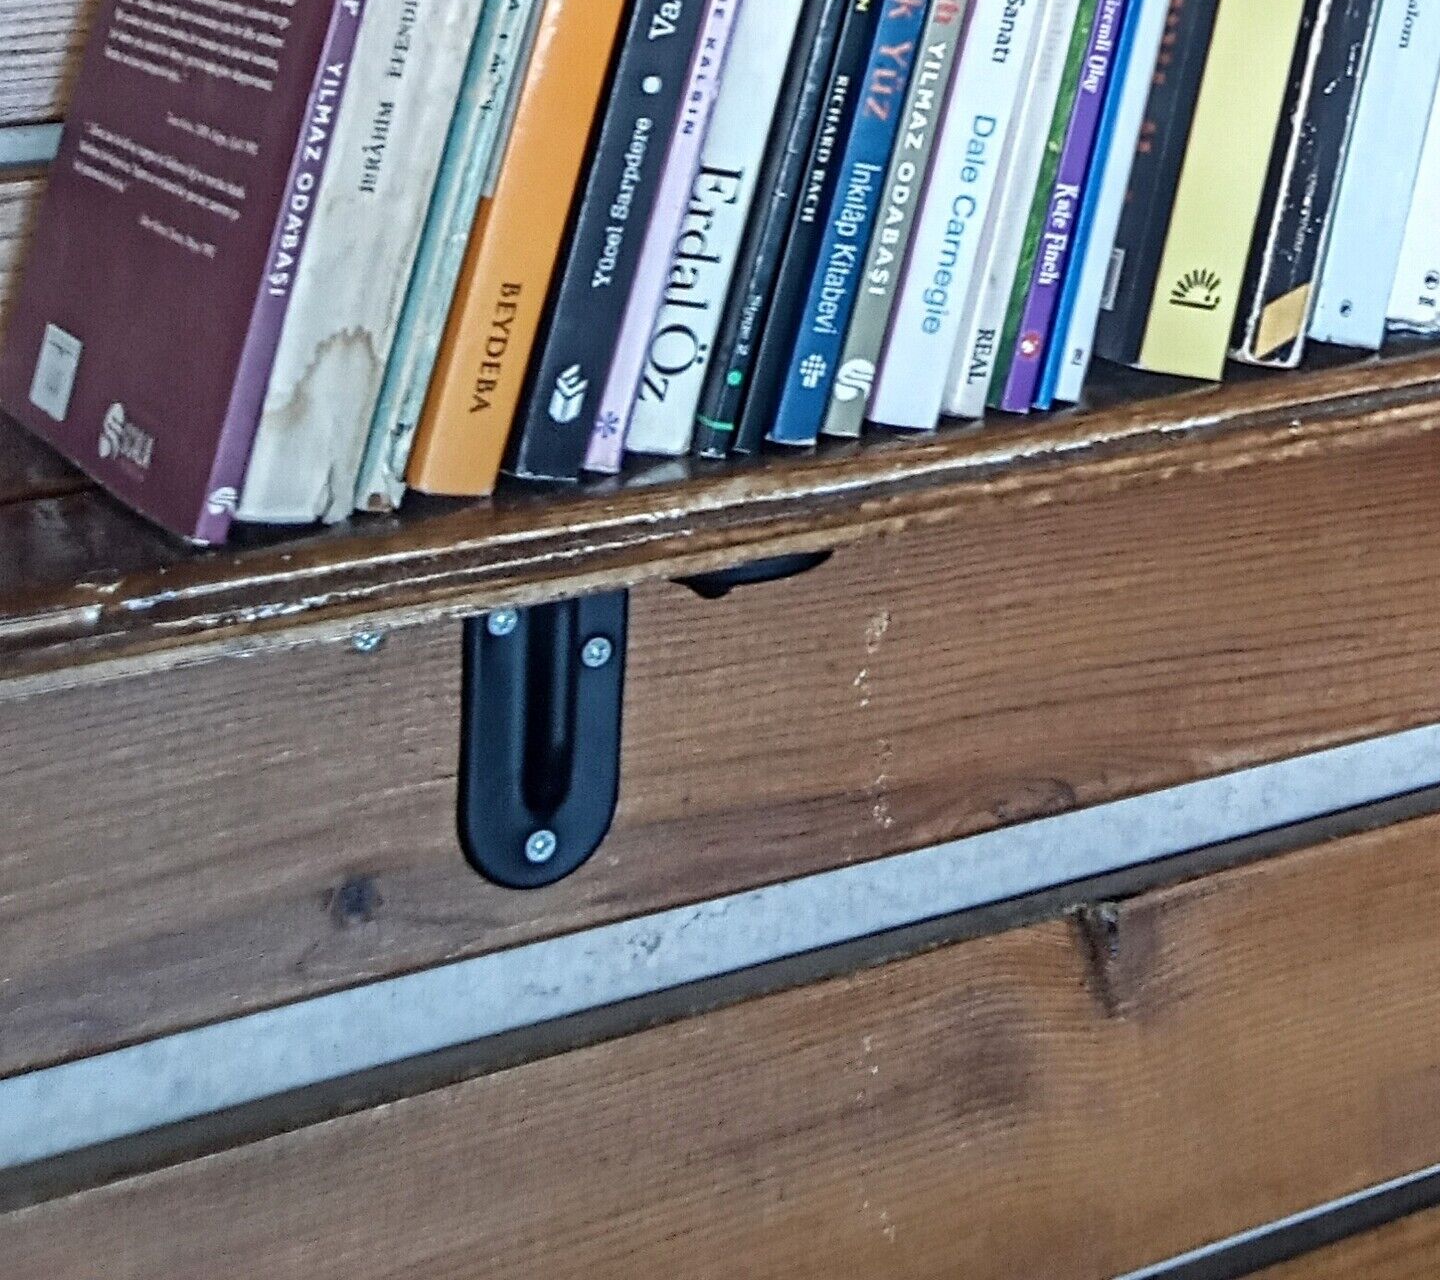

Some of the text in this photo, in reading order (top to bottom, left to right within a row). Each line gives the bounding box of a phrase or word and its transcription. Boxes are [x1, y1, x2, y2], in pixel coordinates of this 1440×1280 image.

[302, 60, 342, 162] YILMAZ
[815, 75, 850, 163] RICHARD
[862, 35, 915, 123] Yüz
[903, 40, 947, 151] YILMAZ
[800, 168, 826, 223] BACH
[958, 112, 996, 185] Dale
[266, 170, 315, 297] ODABAŞI
[591, 224, 624, 289] Yücel
[609, 114, 653, 220] Sarpdere
[660, 159, 746, 315] Erdal
[864, 159, 917, 296] ODABAŞI
[1050, 182, 1080, 229] Kate
[811, 241, 859, 336] Kitabevi
[916, 193, 978, 337] Carnegie
[468, 281, 523, 416] BEYDEBA
[636, 317, 709, 412] Öz
[966, 327, 995, 386] REAL
